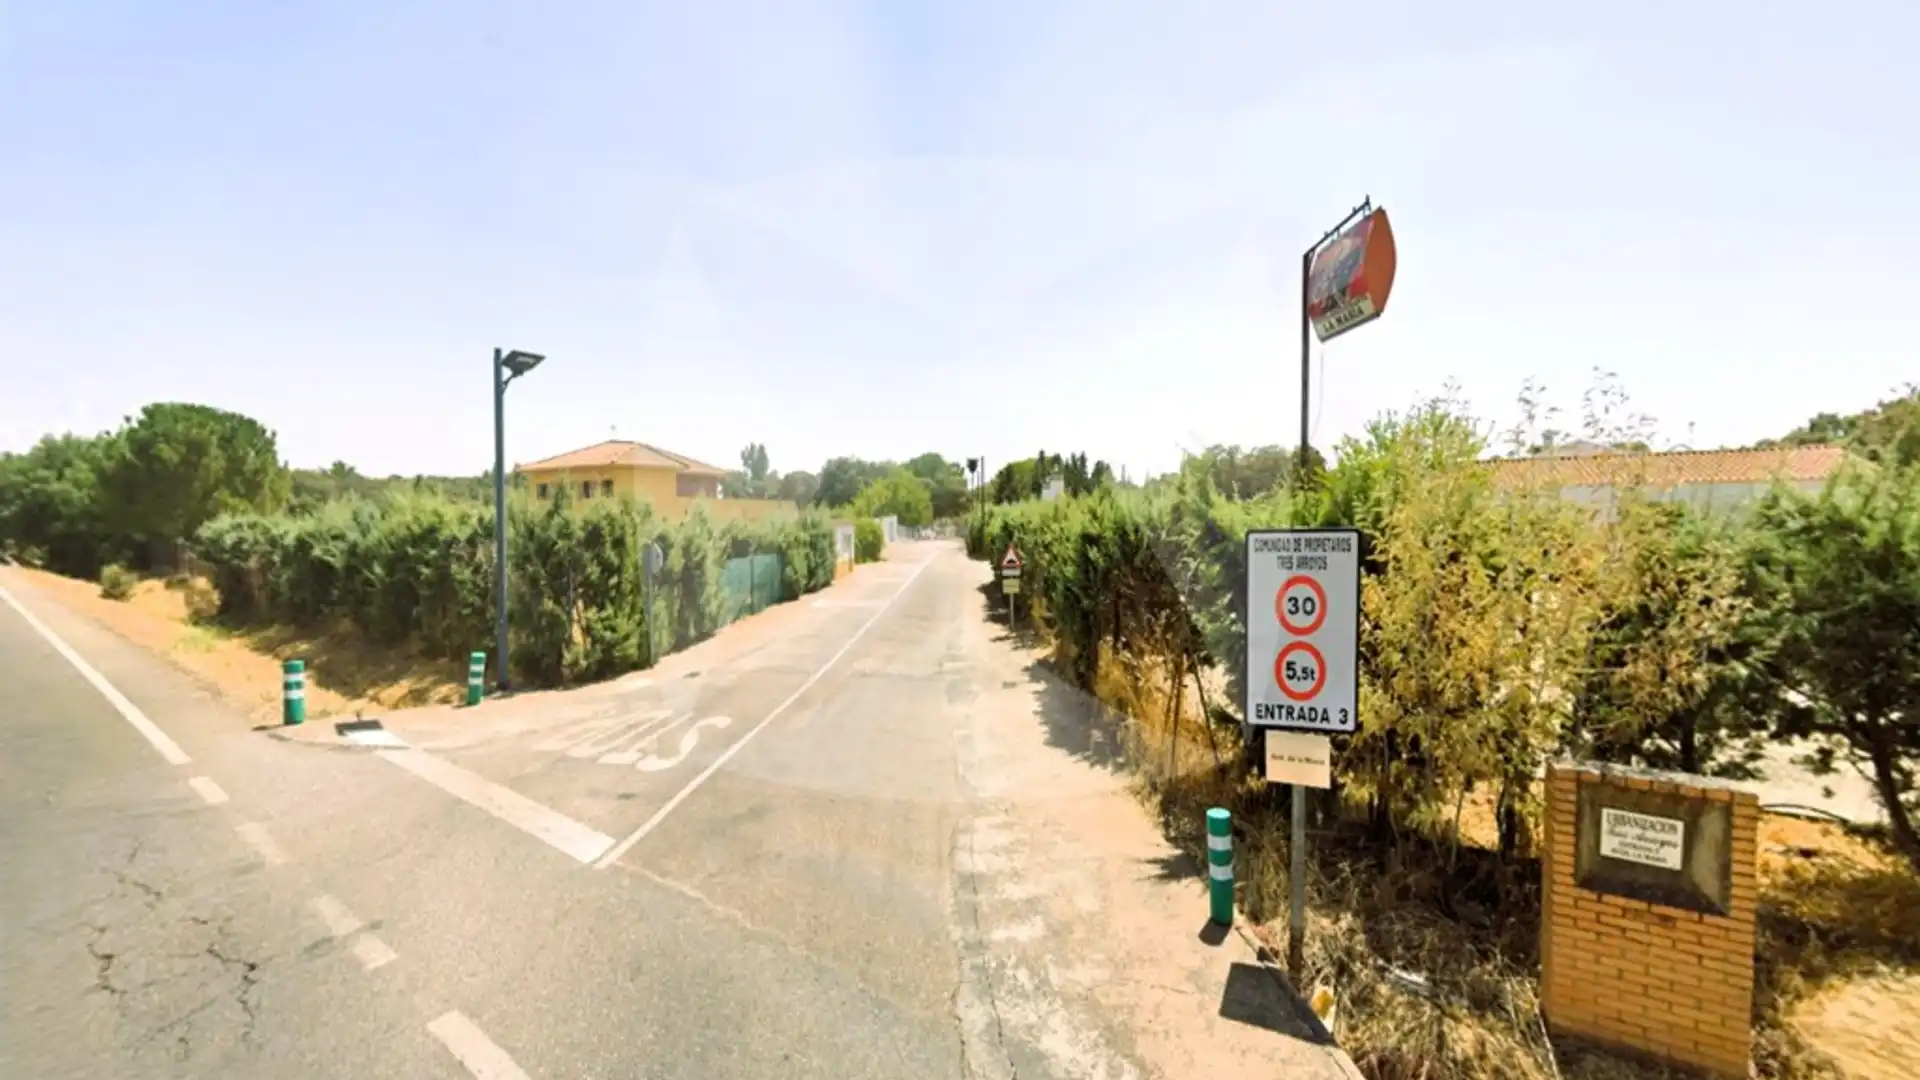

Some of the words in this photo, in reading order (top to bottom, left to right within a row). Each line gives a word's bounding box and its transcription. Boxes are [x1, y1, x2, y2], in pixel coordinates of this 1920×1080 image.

[1293, 537, 1302, 553] DE
[1277, 556, 1293, 570] TRES
[1295, 555, 1328, 571] ARROYOS
[1287, 596, 1316, 616] 30
[1285, 660, 1316, 682] 5,5t
[1255, 703, 1330, 724] ENTRADA
[1338, 708, 1348, 725] 3
